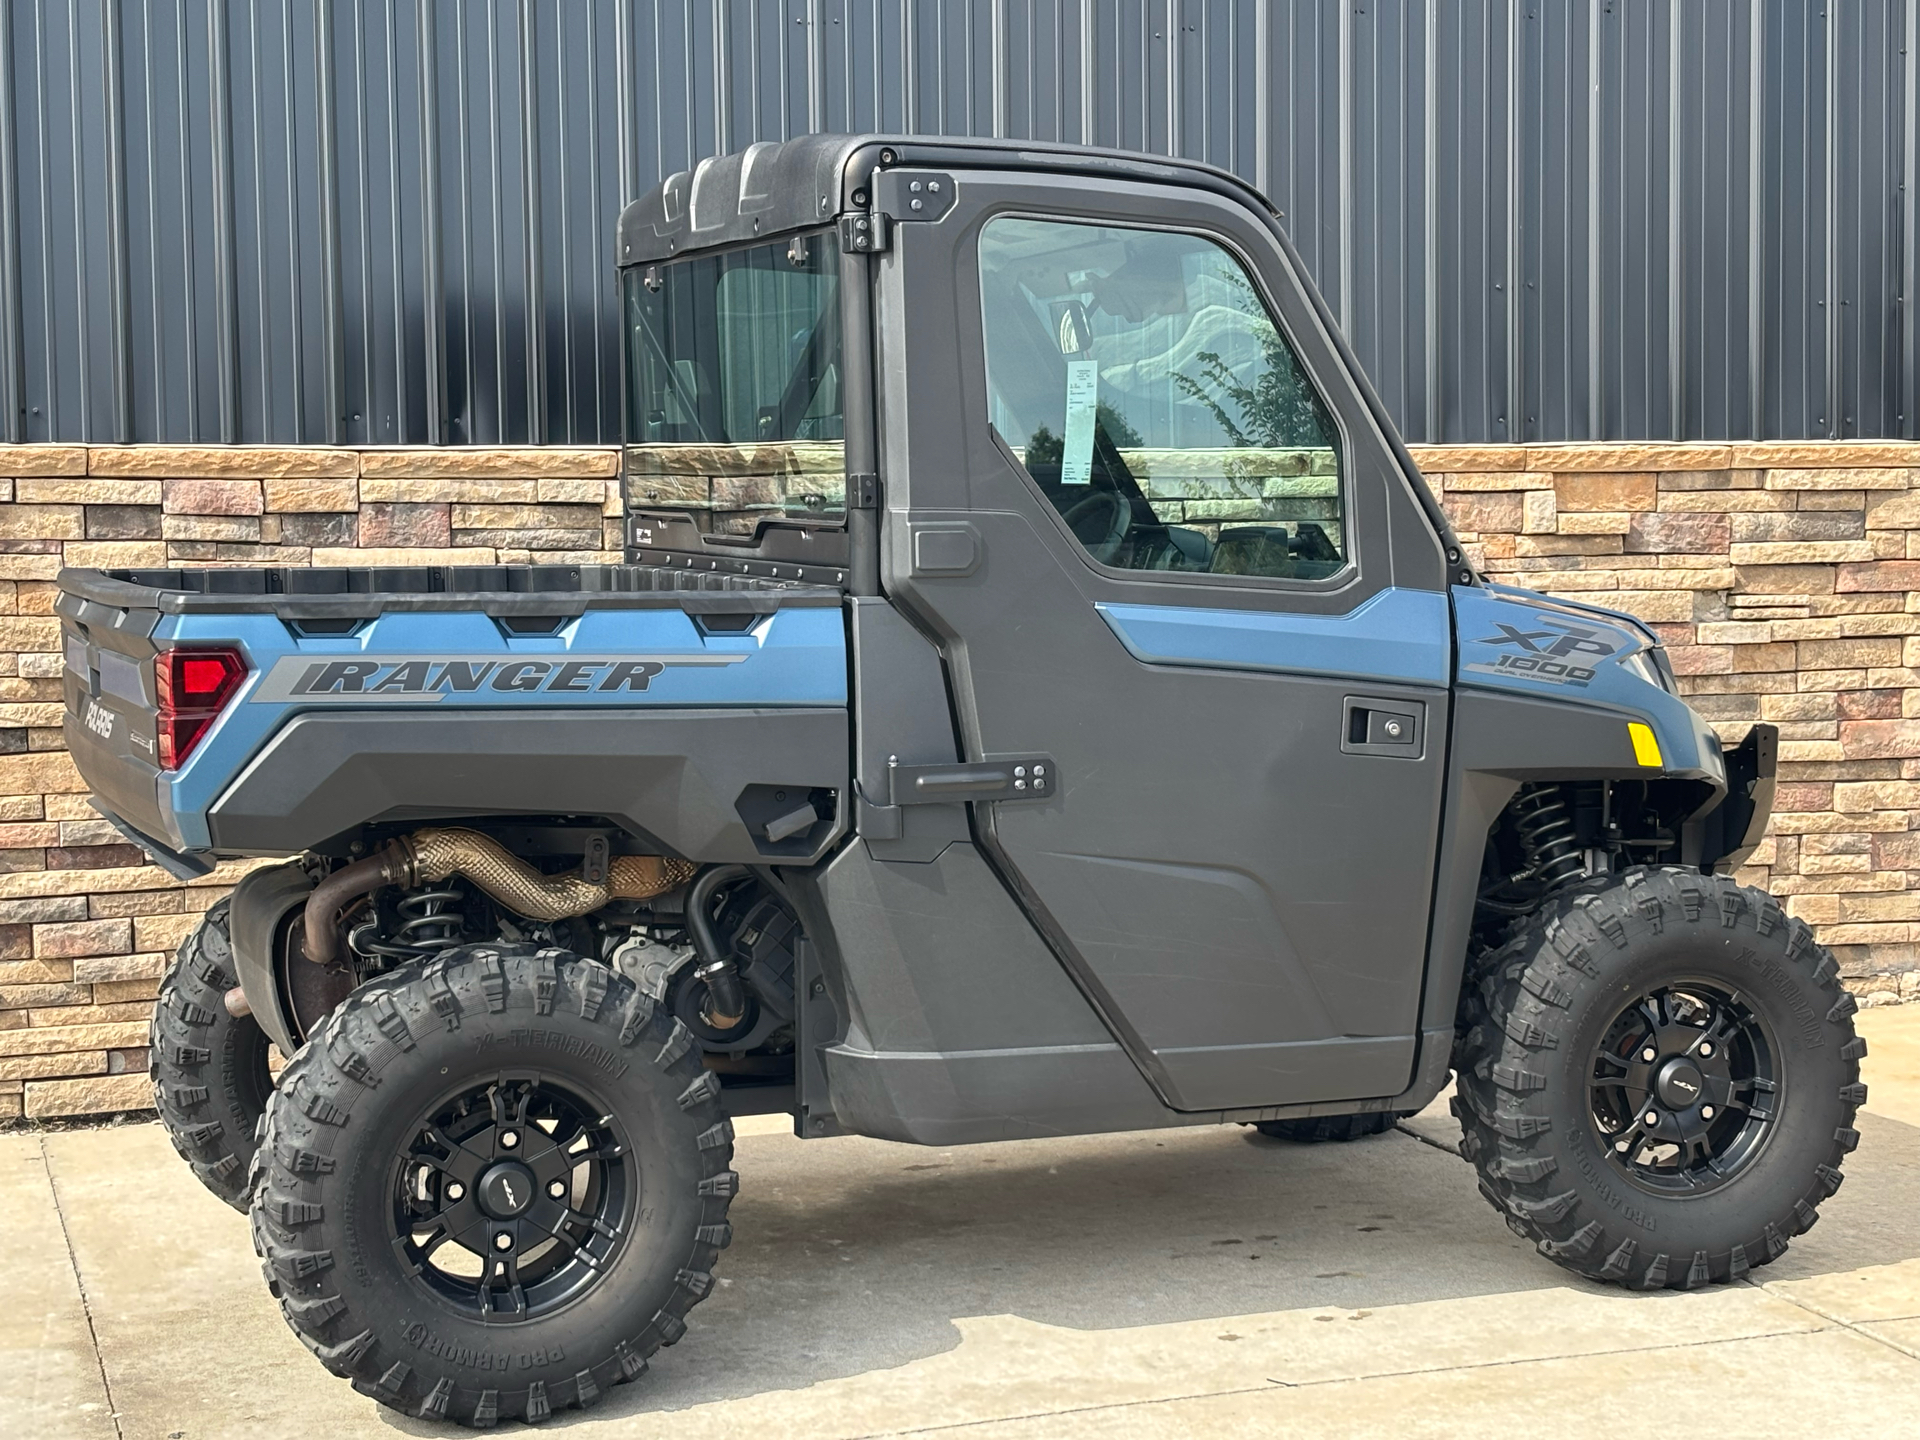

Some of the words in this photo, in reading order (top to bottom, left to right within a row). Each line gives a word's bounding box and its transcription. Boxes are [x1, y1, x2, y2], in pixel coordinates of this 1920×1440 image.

[1475, 622, 1616, 657] XP
[304, 660, 666, 694] RANGER
[1496, 655, 1597, 681] 1000
[84, 701, 116, 739] POLARIS
[1733, 946, 1826, 1051] X-TERRAIN
[474, 1027, 630, 1080] X-TERRAIN
[1572, 1146, 1623, 1210] ARMOR
[422, 1333, 511, 1372] ARMOR
[515, 1343, 566, 1371] PRO
